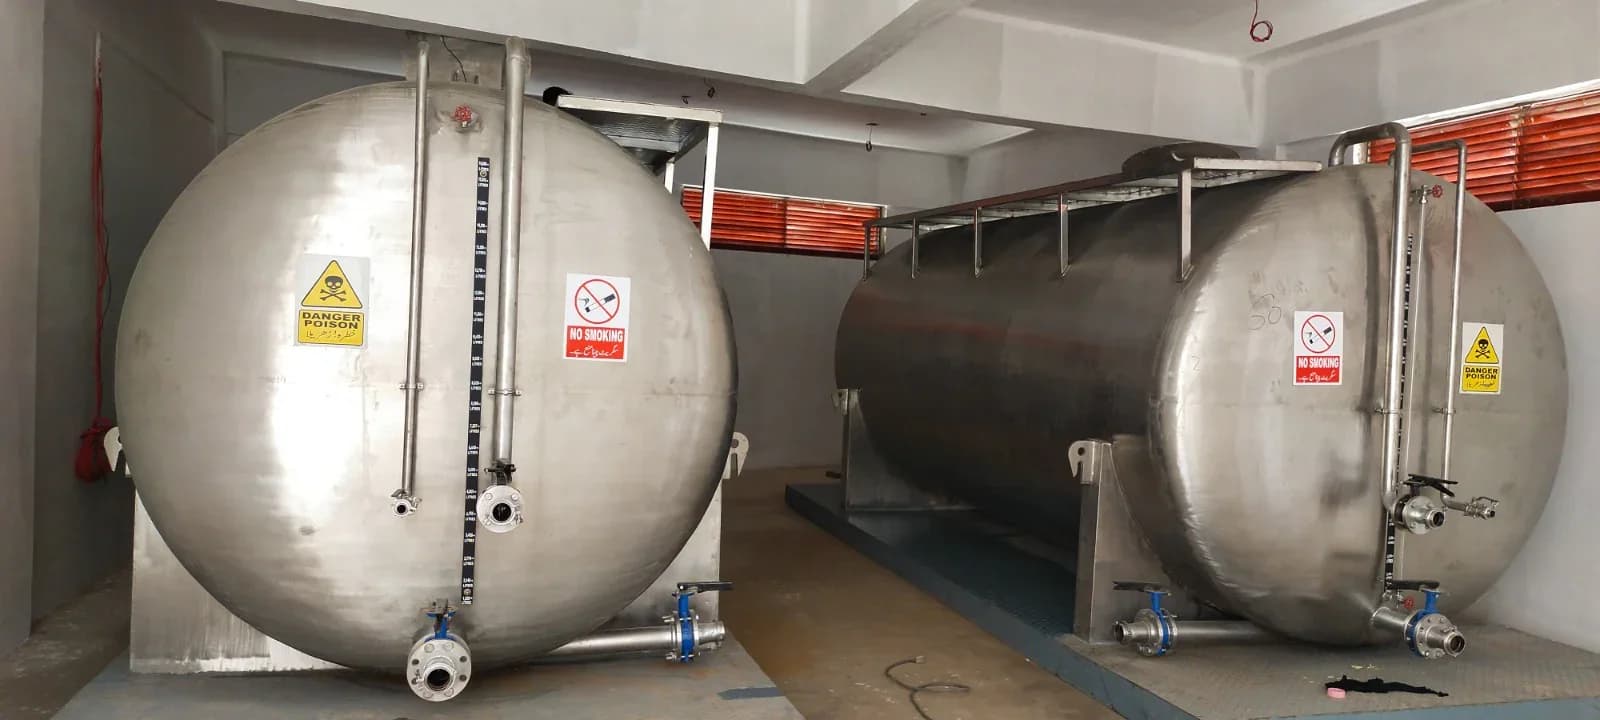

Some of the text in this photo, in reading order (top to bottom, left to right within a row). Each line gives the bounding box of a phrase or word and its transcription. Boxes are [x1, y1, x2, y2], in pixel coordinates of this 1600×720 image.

[302, 312, 361, 322] DANGER
[304, 319, 358, 329] POISON
[570, 327, 624, 342] NO SMOKING
[1298, 356, 1339, 369] NO SMOKING
